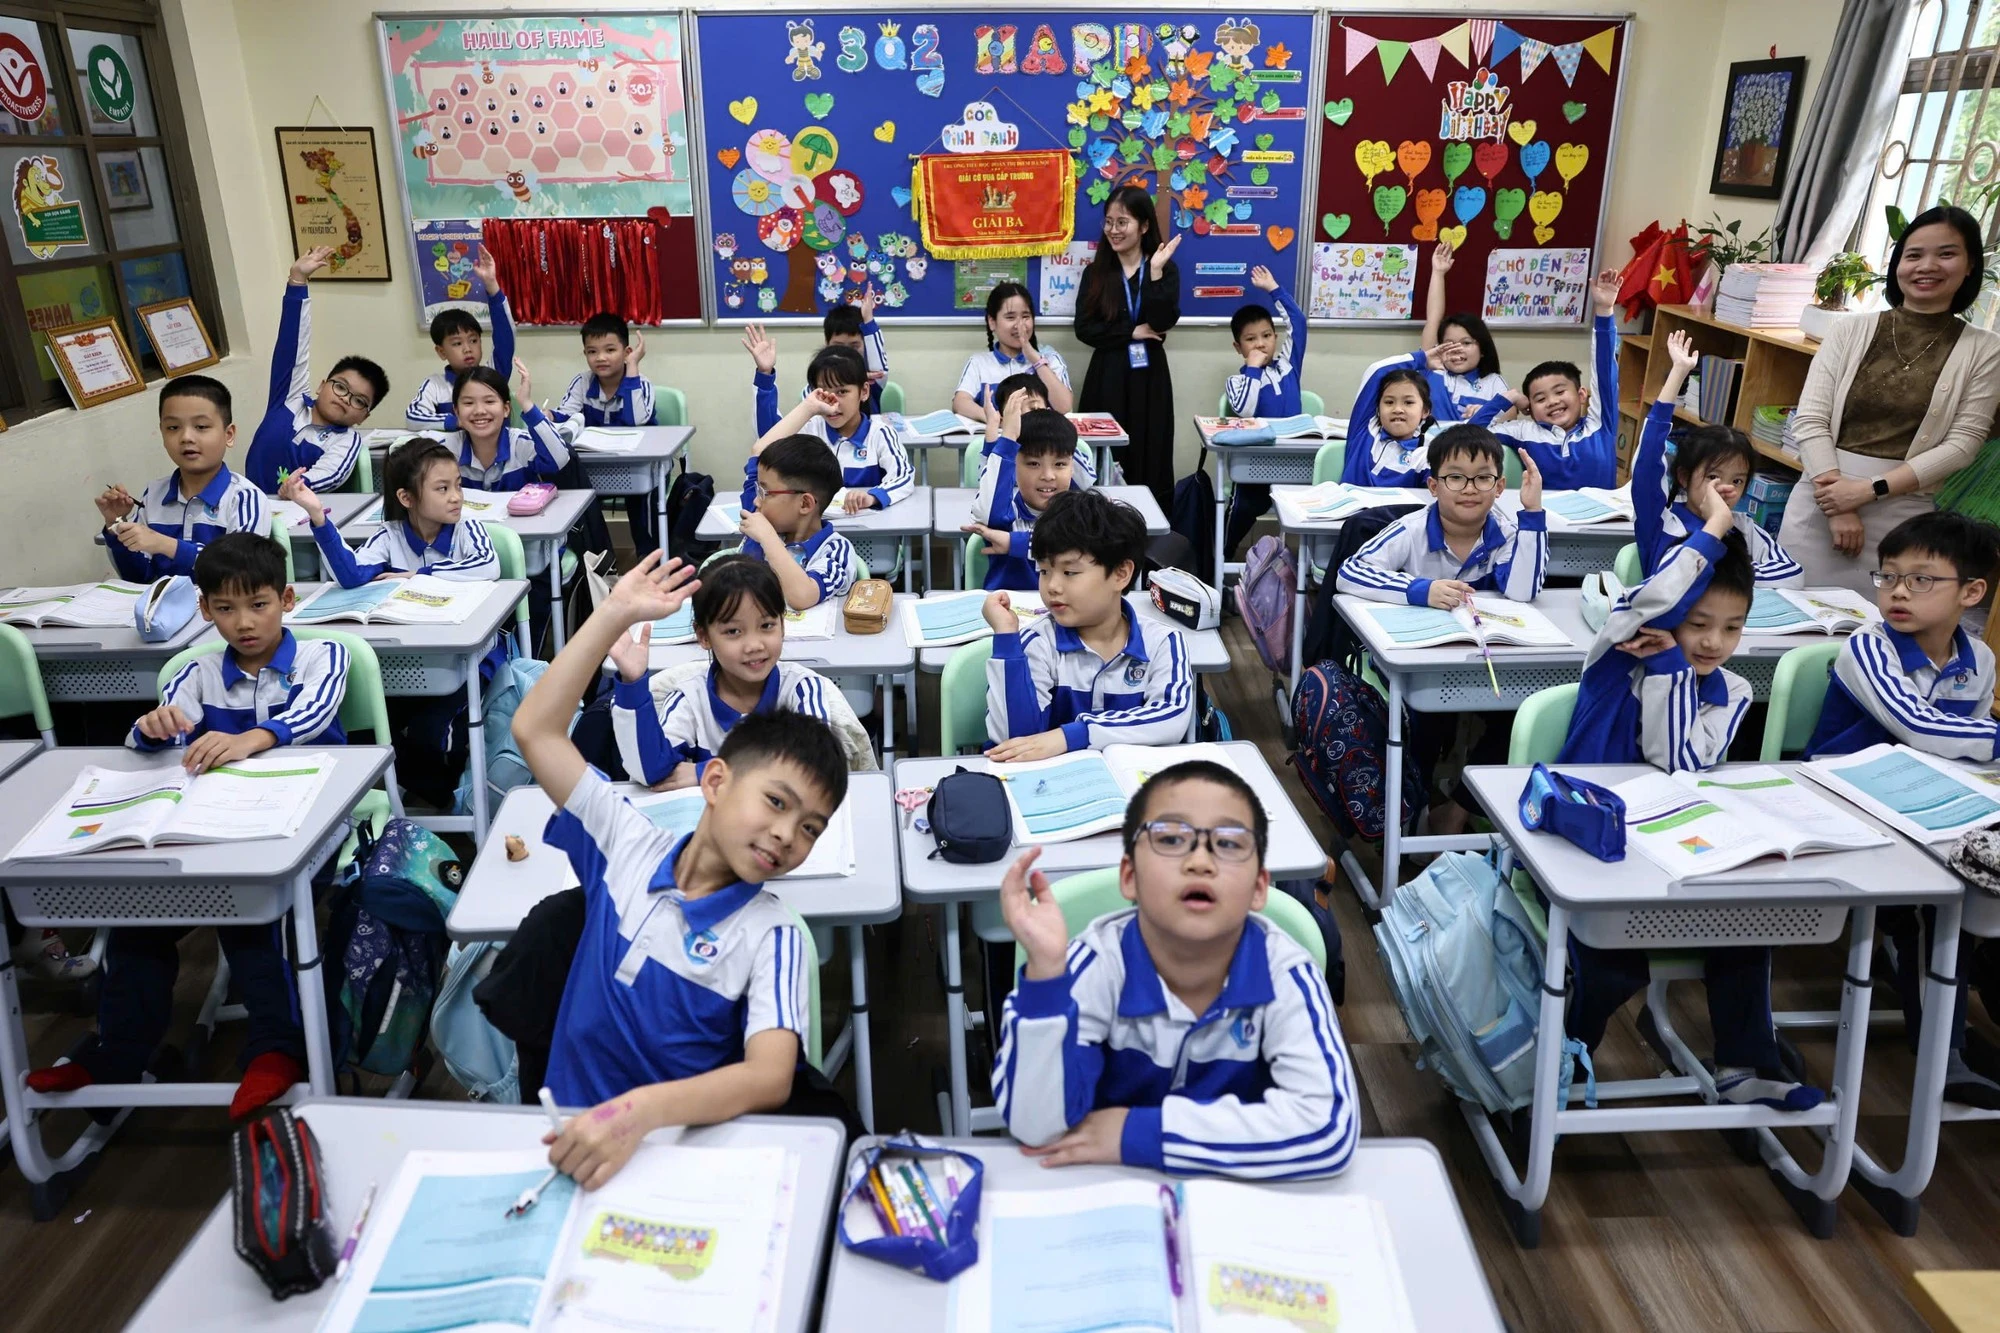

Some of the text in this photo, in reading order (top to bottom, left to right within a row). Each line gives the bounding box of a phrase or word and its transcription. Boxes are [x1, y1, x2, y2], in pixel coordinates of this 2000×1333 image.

[463, 28, 605, 50] HALL OF FAME
[836, 25, 945, 72] 3Q2
[629, 83, 652, 94] 3Q2
[0, 87, 43, 115] PROACTIVENESS
[108, 100, 131, 118] EMPATHY
[972, 213, 1024, 229] GIẢI BA
[1050, 252, 1073, 266] Nói
[1530, 252, 1562, 273] ĐẾN
[1321, 266, 1344, 281] Bàn
